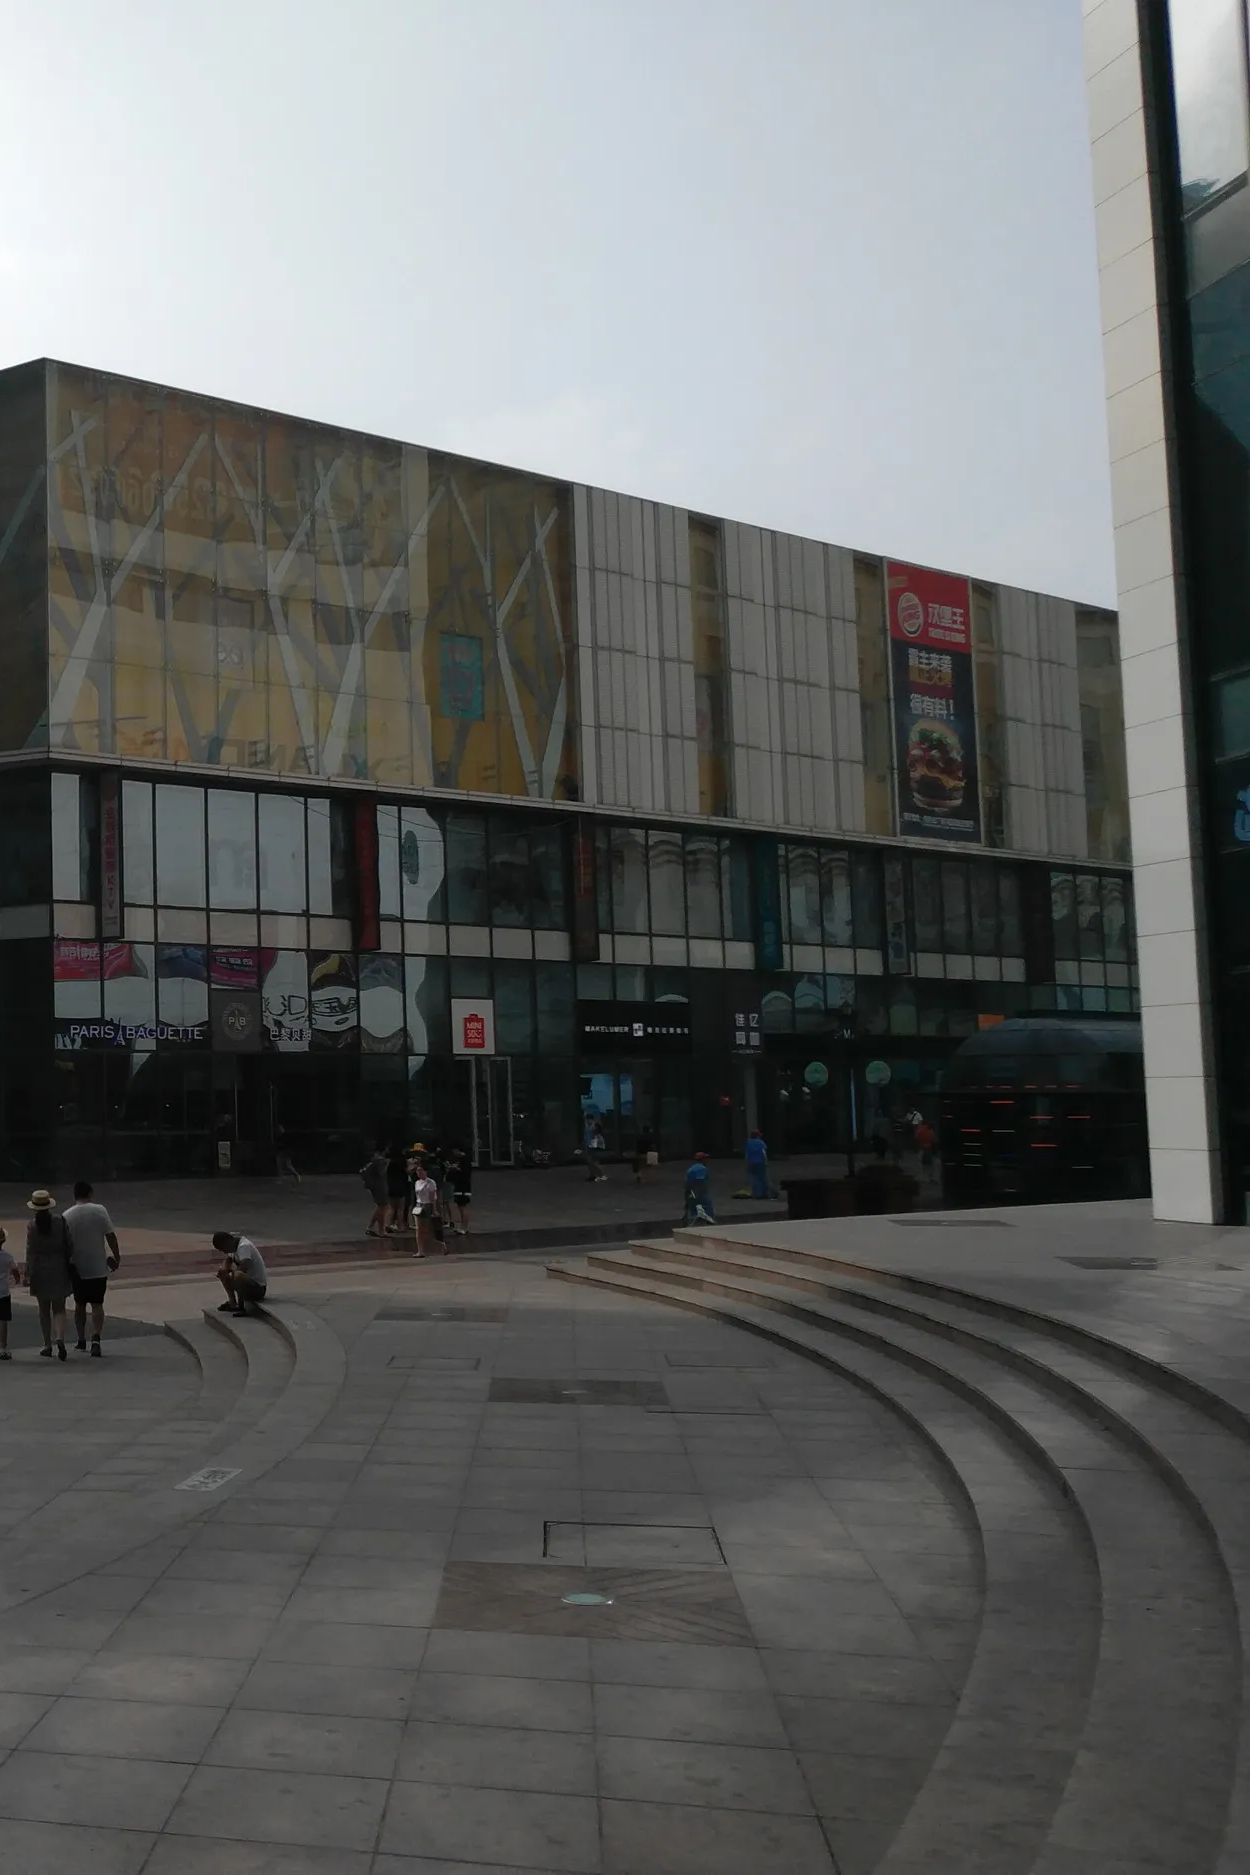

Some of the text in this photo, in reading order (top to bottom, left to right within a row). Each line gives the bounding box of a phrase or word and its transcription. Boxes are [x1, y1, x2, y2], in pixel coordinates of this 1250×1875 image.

[69, 1025, 204, 1040] PARIS BAGUETTE
[269, 1027, 313, 1042] 巴黎贝甜
